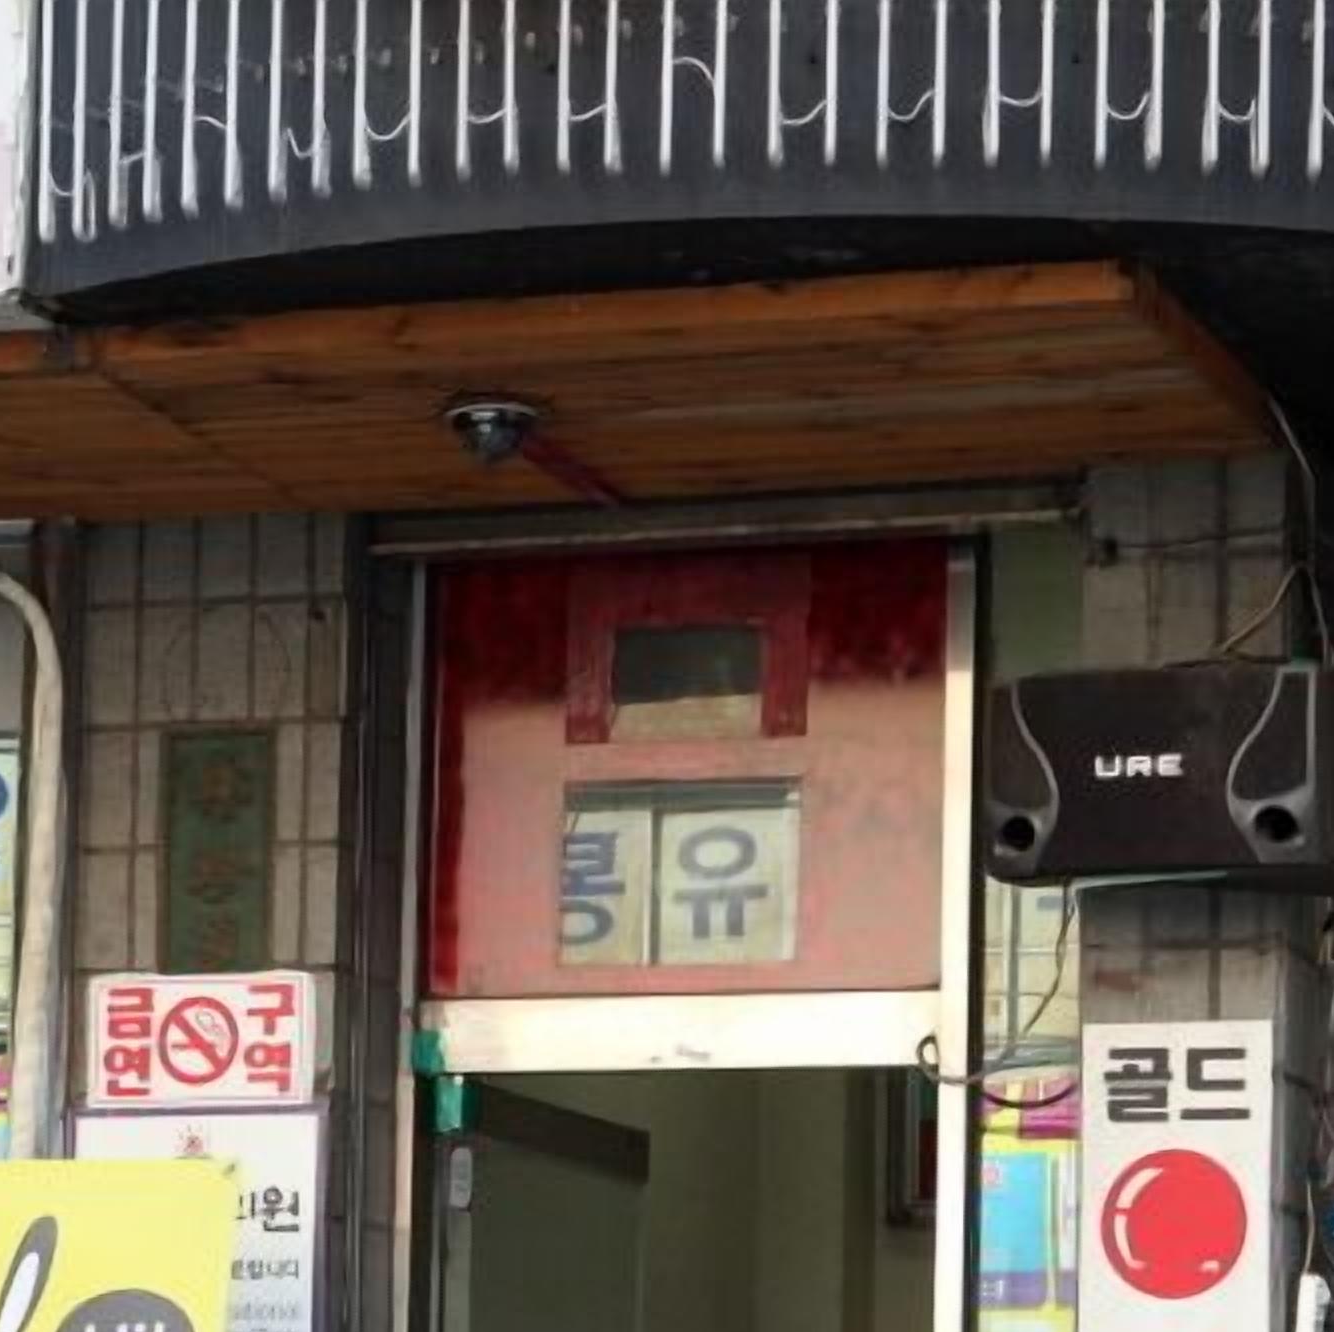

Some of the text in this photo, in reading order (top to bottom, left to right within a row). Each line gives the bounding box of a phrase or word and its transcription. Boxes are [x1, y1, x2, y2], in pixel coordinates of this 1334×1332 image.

[103, 987, 155, 1097] 금연
[243, 983, 295, 1093] 구역
[1104, 1047, 1251, 1122] 골드
